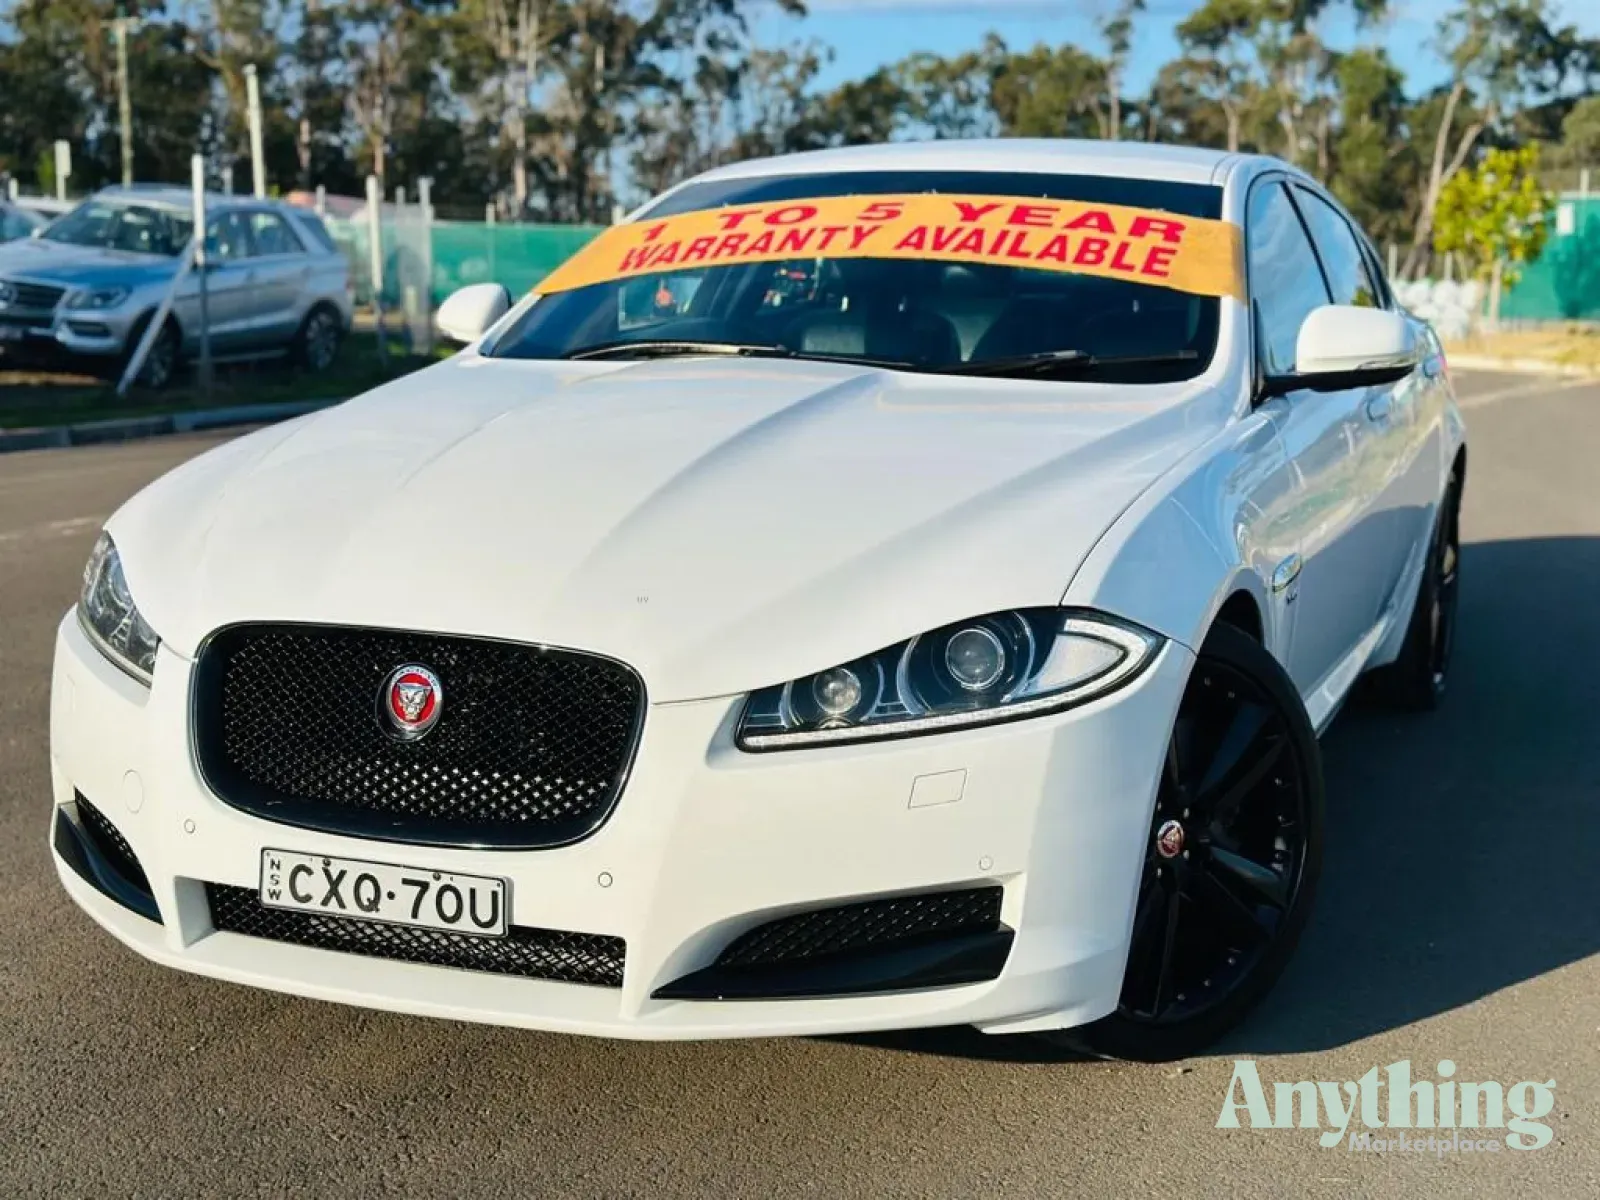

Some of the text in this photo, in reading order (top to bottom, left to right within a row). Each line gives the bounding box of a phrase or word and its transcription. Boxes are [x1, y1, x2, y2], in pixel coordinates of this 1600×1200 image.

[642, 202, 1186, 243] 1 TO 5 YEAR
[618, 225, 1178, 278] WARRANTY AVAILABLE
